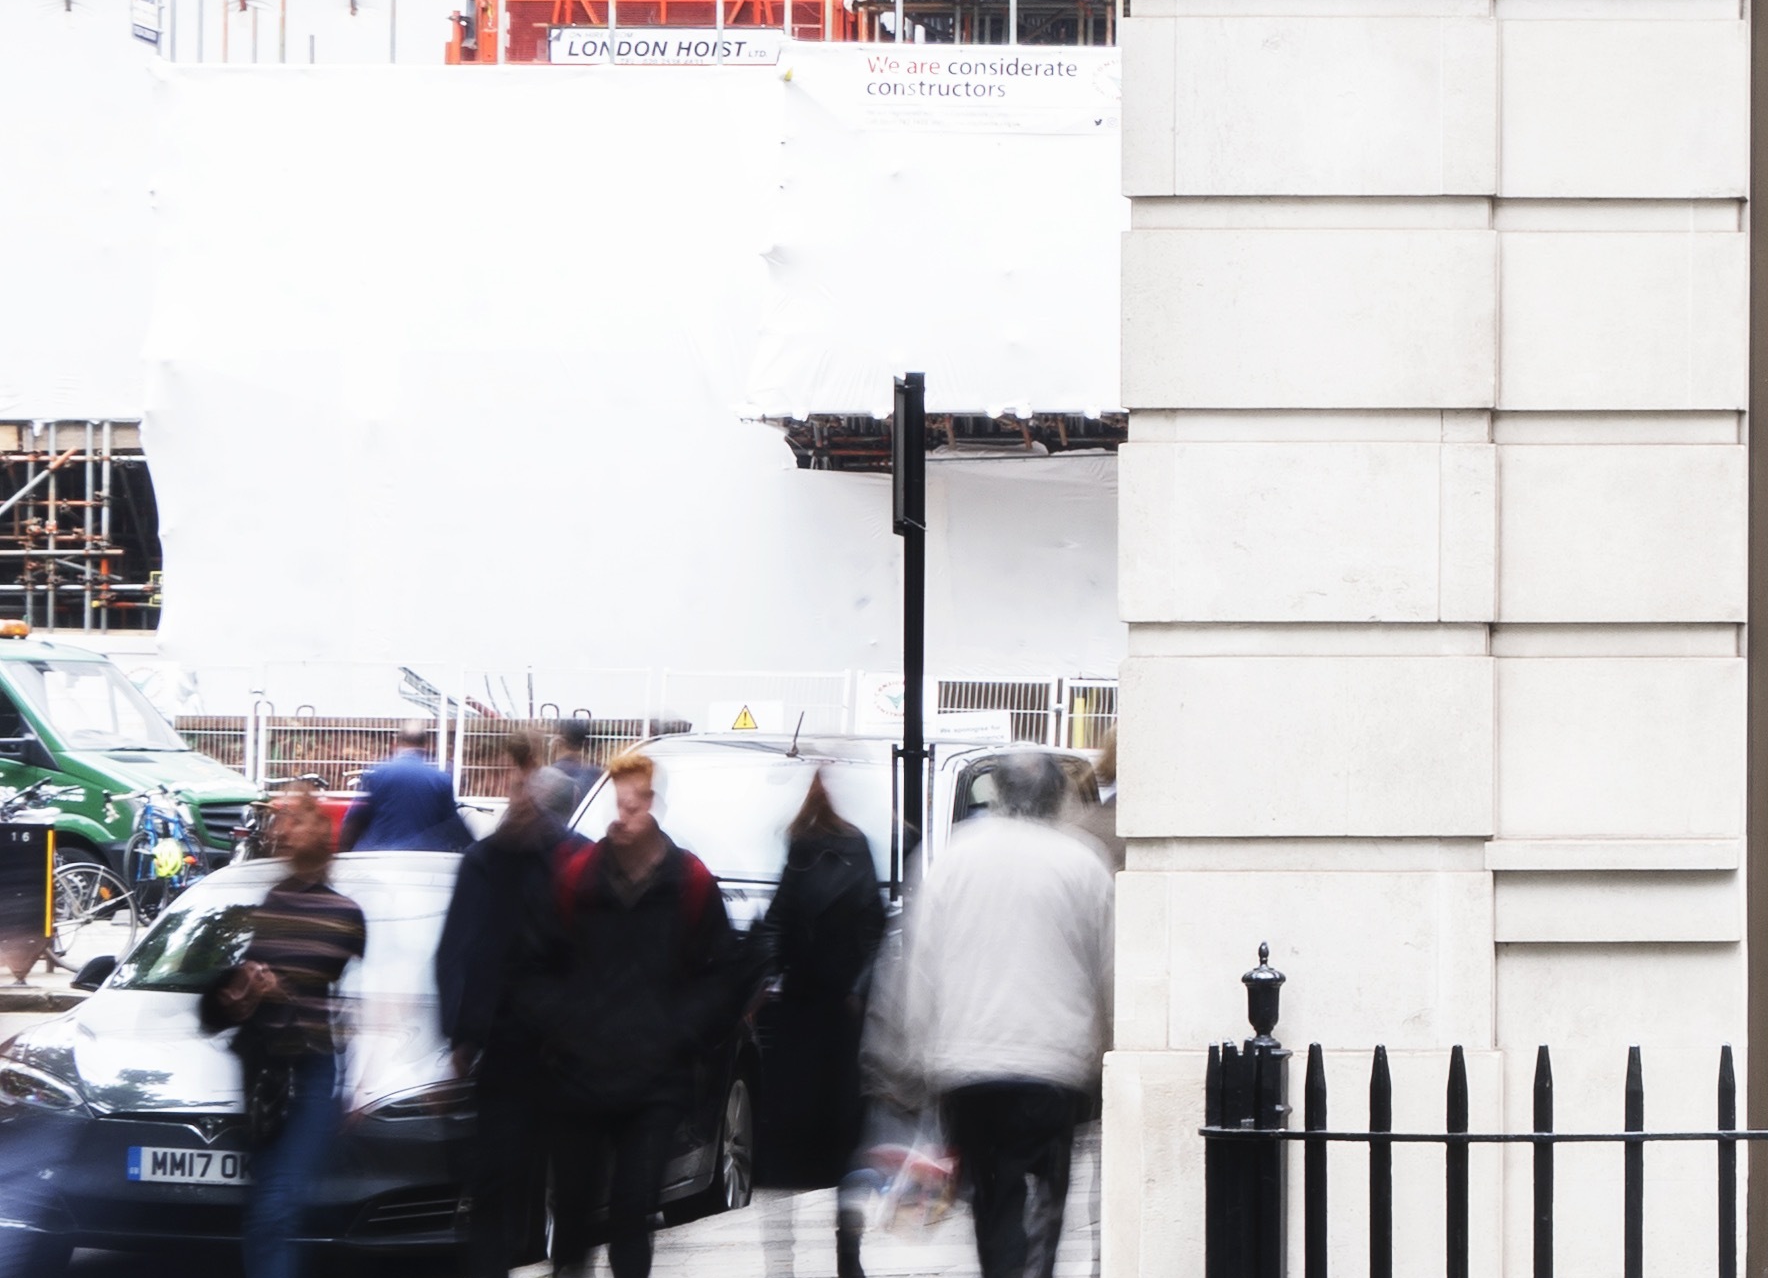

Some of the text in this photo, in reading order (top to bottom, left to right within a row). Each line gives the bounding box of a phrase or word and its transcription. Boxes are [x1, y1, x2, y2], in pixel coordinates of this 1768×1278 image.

[567, 40, 669, 57] LONDON
[676, 40, 748, 57] HOIST
[867, 56, 1078, 77] We are considerate
[866, 80, 1006, 98] constructors
